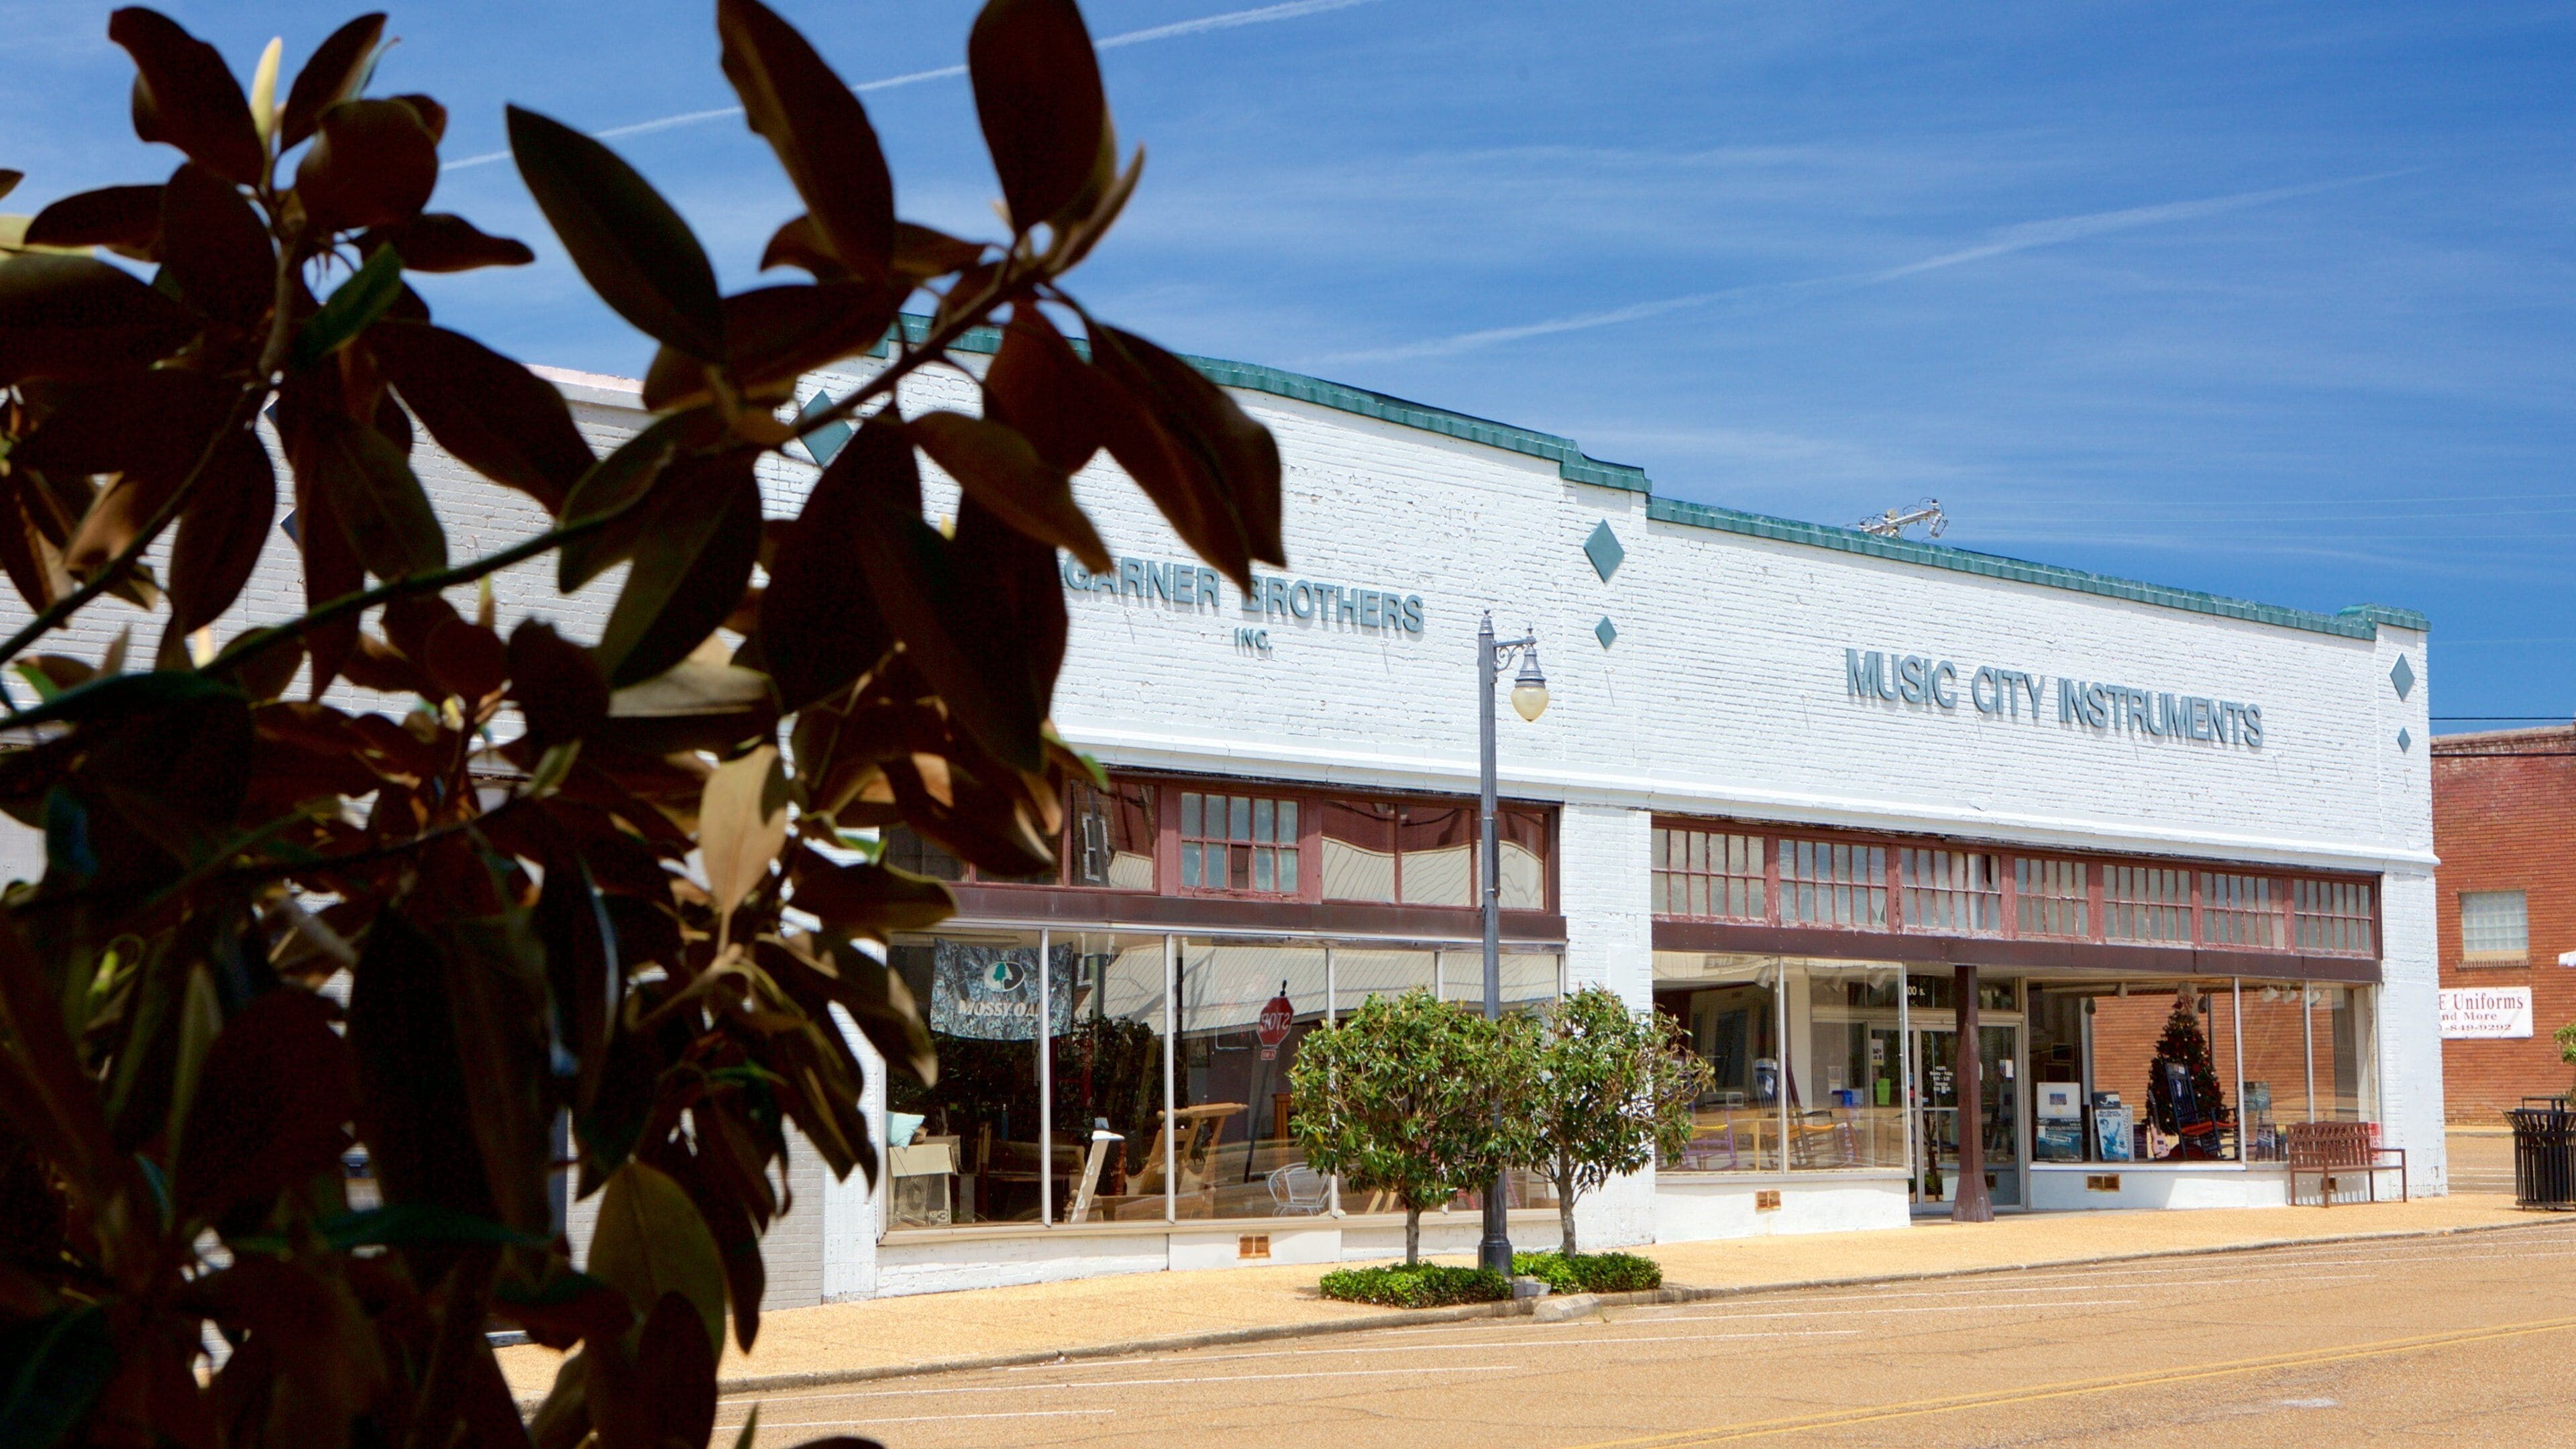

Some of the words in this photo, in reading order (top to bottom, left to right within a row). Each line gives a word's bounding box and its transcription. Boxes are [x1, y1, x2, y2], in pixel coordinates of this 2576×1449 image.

[1064, 553, 1220, 606] GARNER
[1240, 575, 1424, 633] BROTHERS
[1234, 627, 1273, 651] INC.
[1846, 648, 1957, 708] MUSIC
[1972, 665, 2045, 718] CITY
[2058, 678, 2263, 747] INSTRUMENTS
[1908, 986, 1917, 996] 00
[959, 1001, 1012, 1017] MOSSY
[2454, 993, 2524, 1010] Uniforms
[2442, 1012, 2457, 1020] nd
[2464, 1012, 2498, 1020] More
